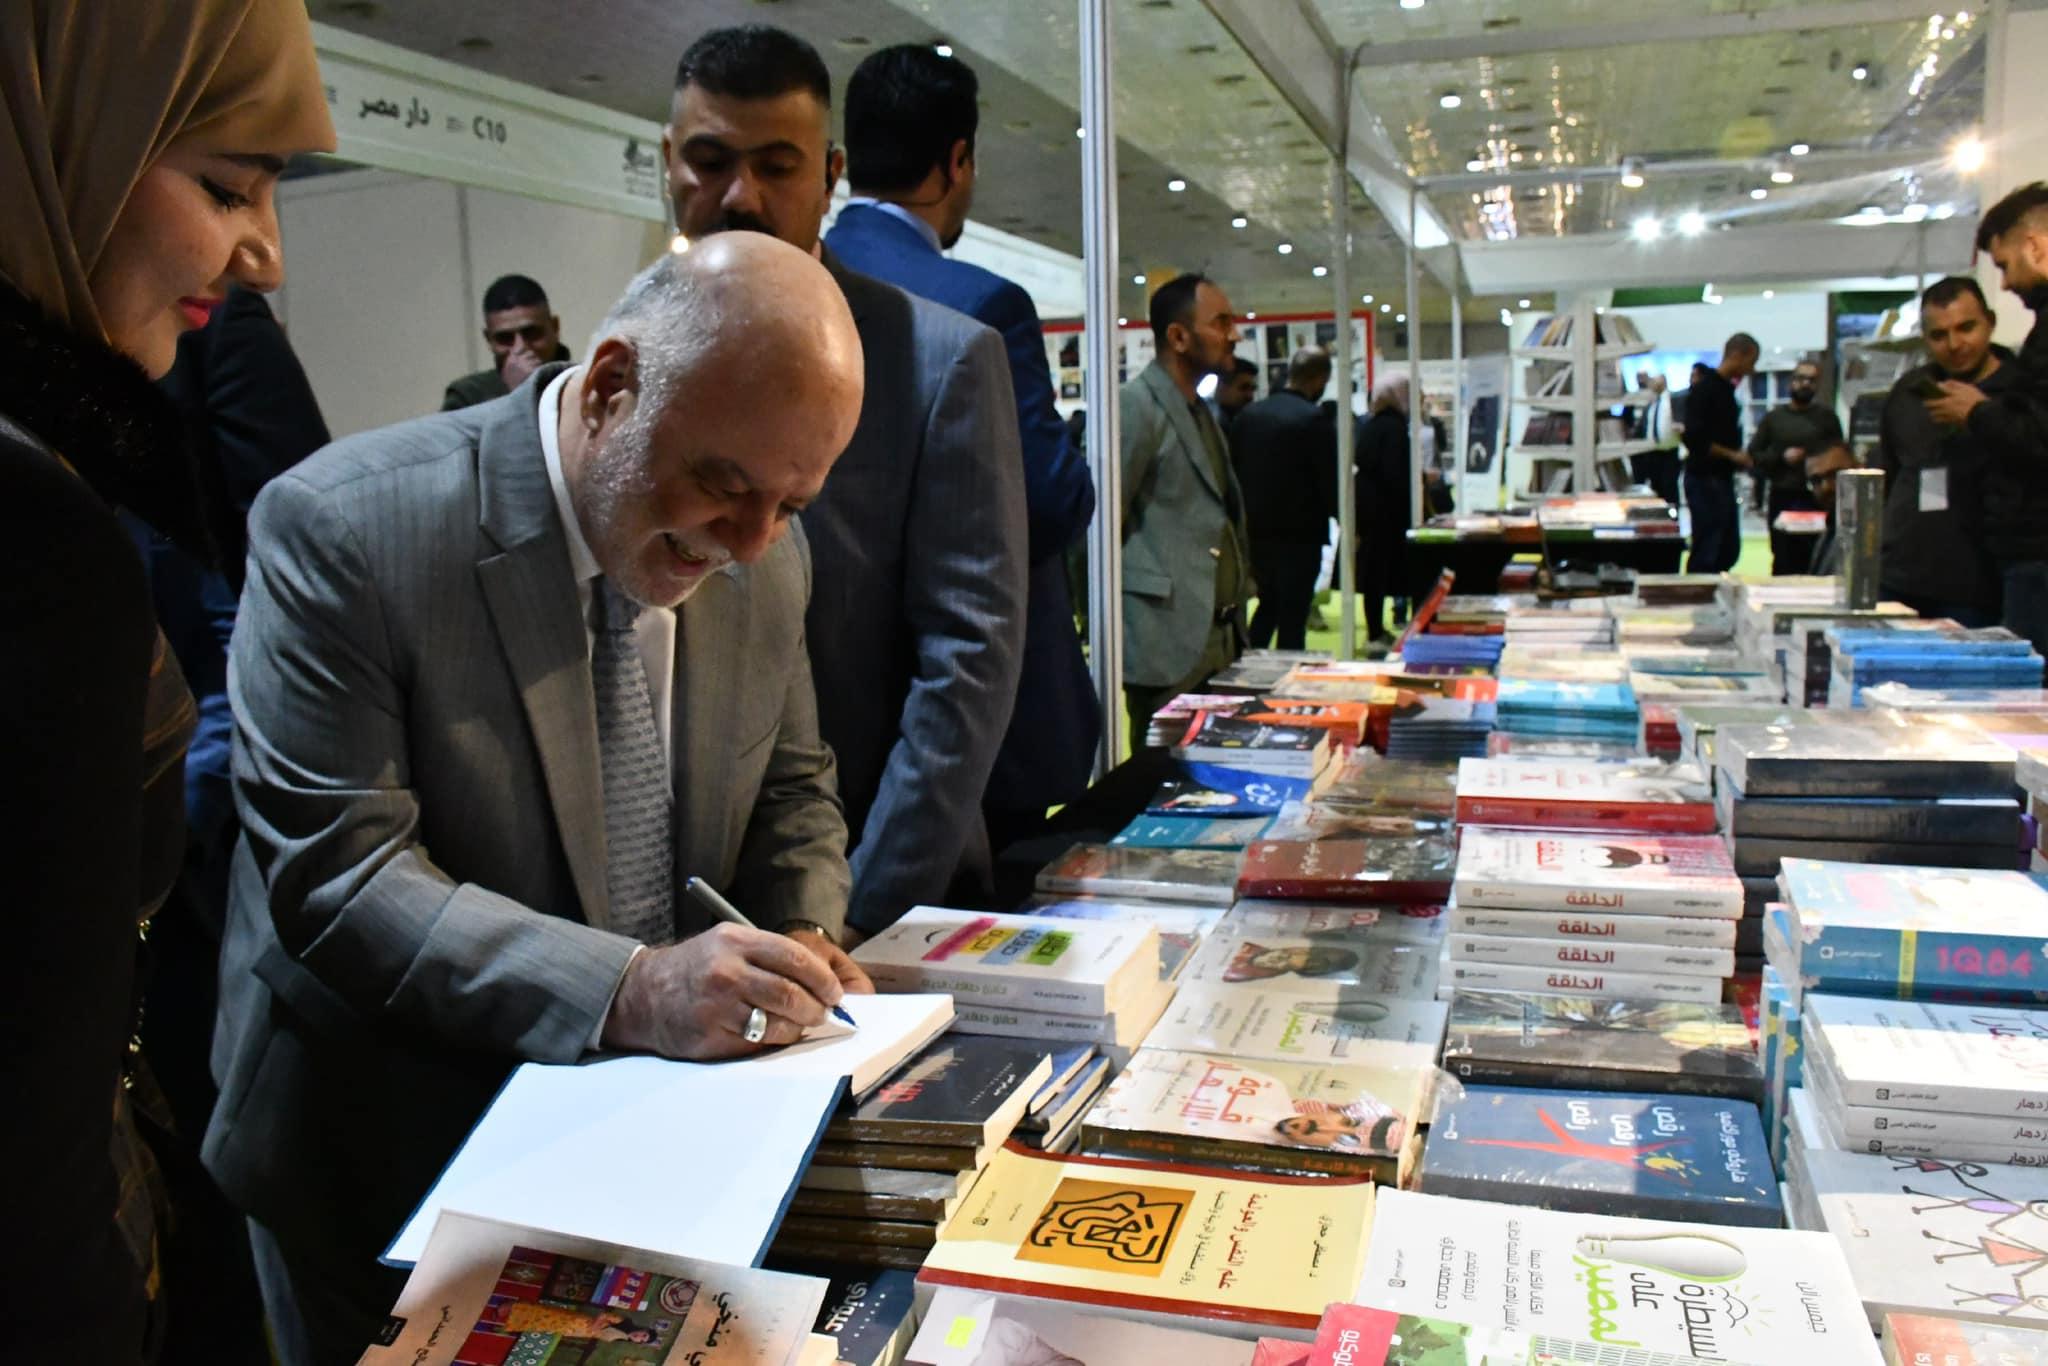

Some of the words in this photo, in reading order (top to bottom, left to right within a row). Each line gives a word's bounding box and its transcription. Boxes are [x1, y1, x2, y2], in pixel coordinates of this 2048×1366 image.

[359, 98, 399, 119] مصر
[404, 98, 430, 128] دار
[472, 115, 508, 143] C10
[1565, 891, 1625, 908] الحلقة
[1557, 919, 1616, 937] الحلقة
[1557, 946, 1615, 964] الحلقة
[1934, 945, 2034, 978] 1Q84
[1546, 973, 1604, 991] الحلقة
[1218, 1075, 1273, 1124] قوة
[1566, 1100, 1599, 1131] رقص
[1610, 1113, 1643, 1146] رقص
[1652, 1106, 1685, 1138] رقص
[1227, 1233, 1249, 1267] النفس
[1218, 1268, 1239, 1289] علم
[1629, 1271, 1665, 1311] على
[1572, 1254, 1641, 1348] لمصير
[1674, 1283, 1728, 1362] لسيطرة
